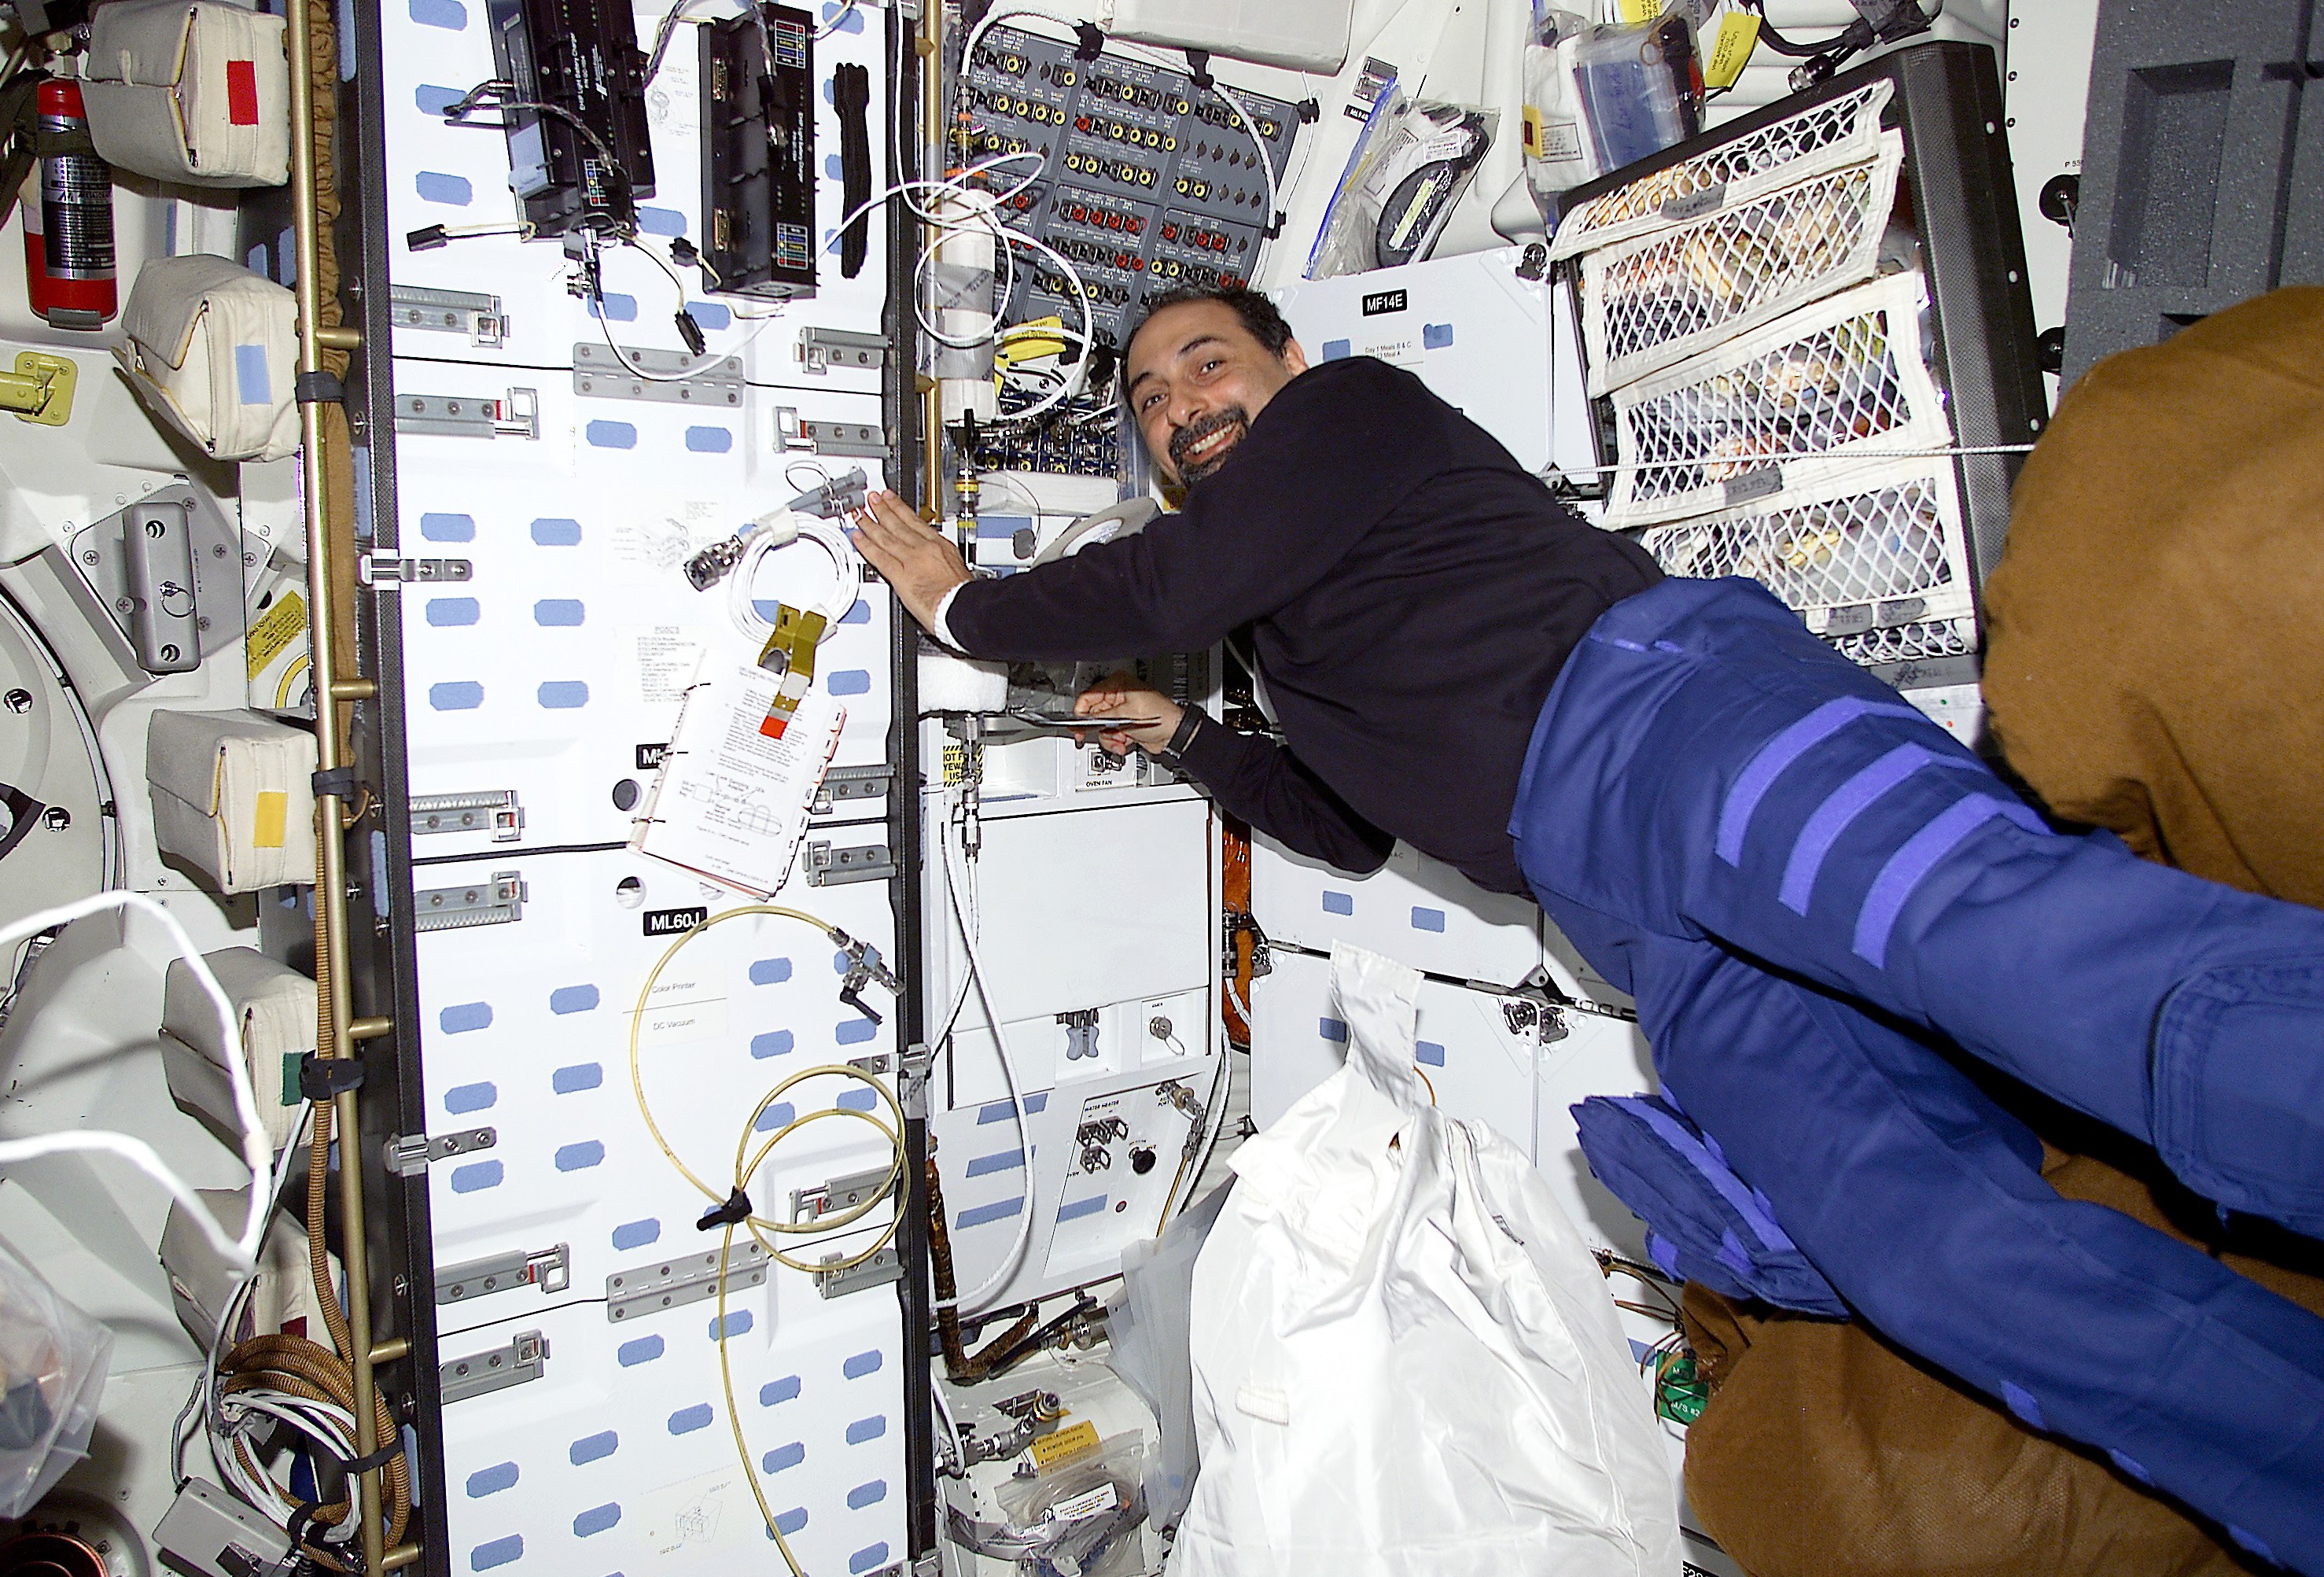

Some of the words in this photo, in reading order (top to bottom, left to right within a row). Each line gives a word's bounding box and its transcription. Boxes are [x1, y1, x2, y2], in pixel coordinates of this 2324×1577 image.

[1367, 293, 1403, 312] MF14E
[651, 912, 701, 931] ML60J
[653, 1022, 665, 1030] DC
